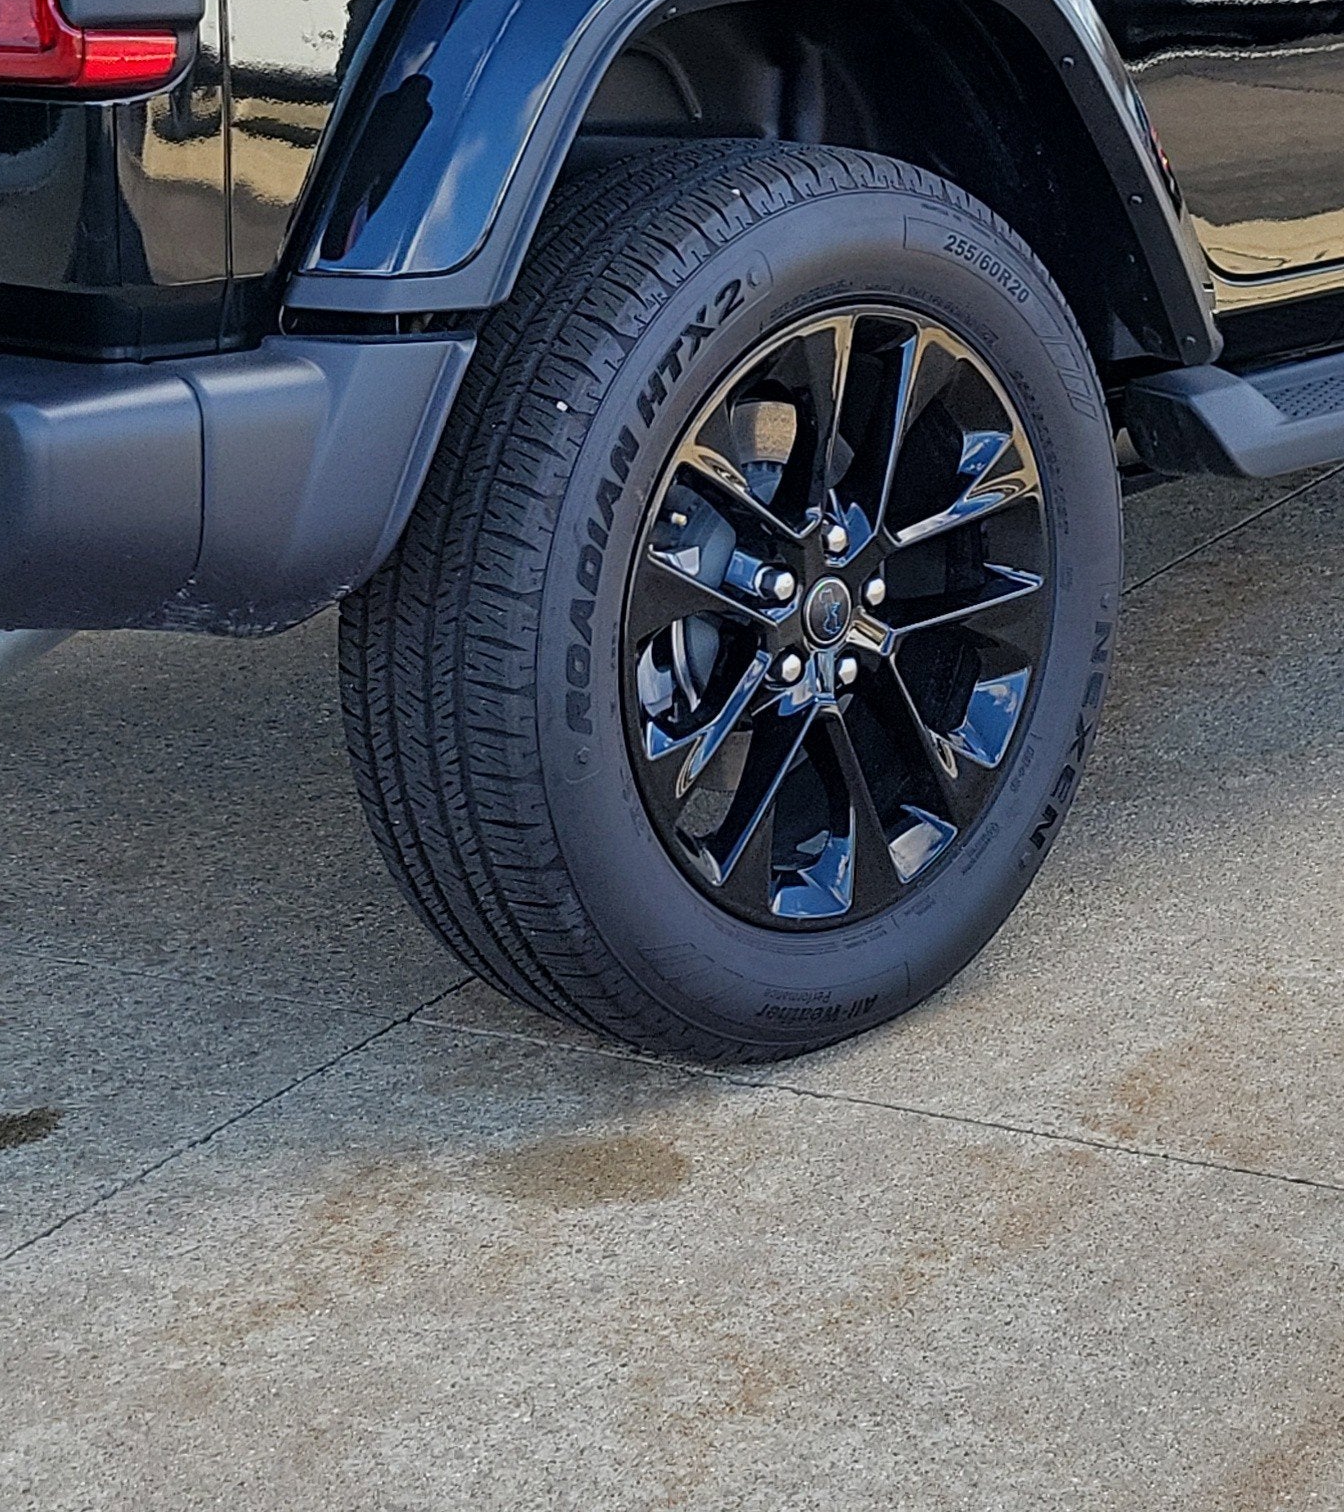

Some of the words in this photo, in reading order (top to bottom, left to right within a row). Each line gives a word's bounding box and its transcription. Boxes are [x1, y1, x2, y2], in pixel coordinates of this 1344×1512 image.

[943, 234, 1030, 304] 255/60R20
[565, 425, 639, 734] ROADIAN
[636, 278, 745, 429] HTX2
[1031, 621, 1113, 850] NEXEN
